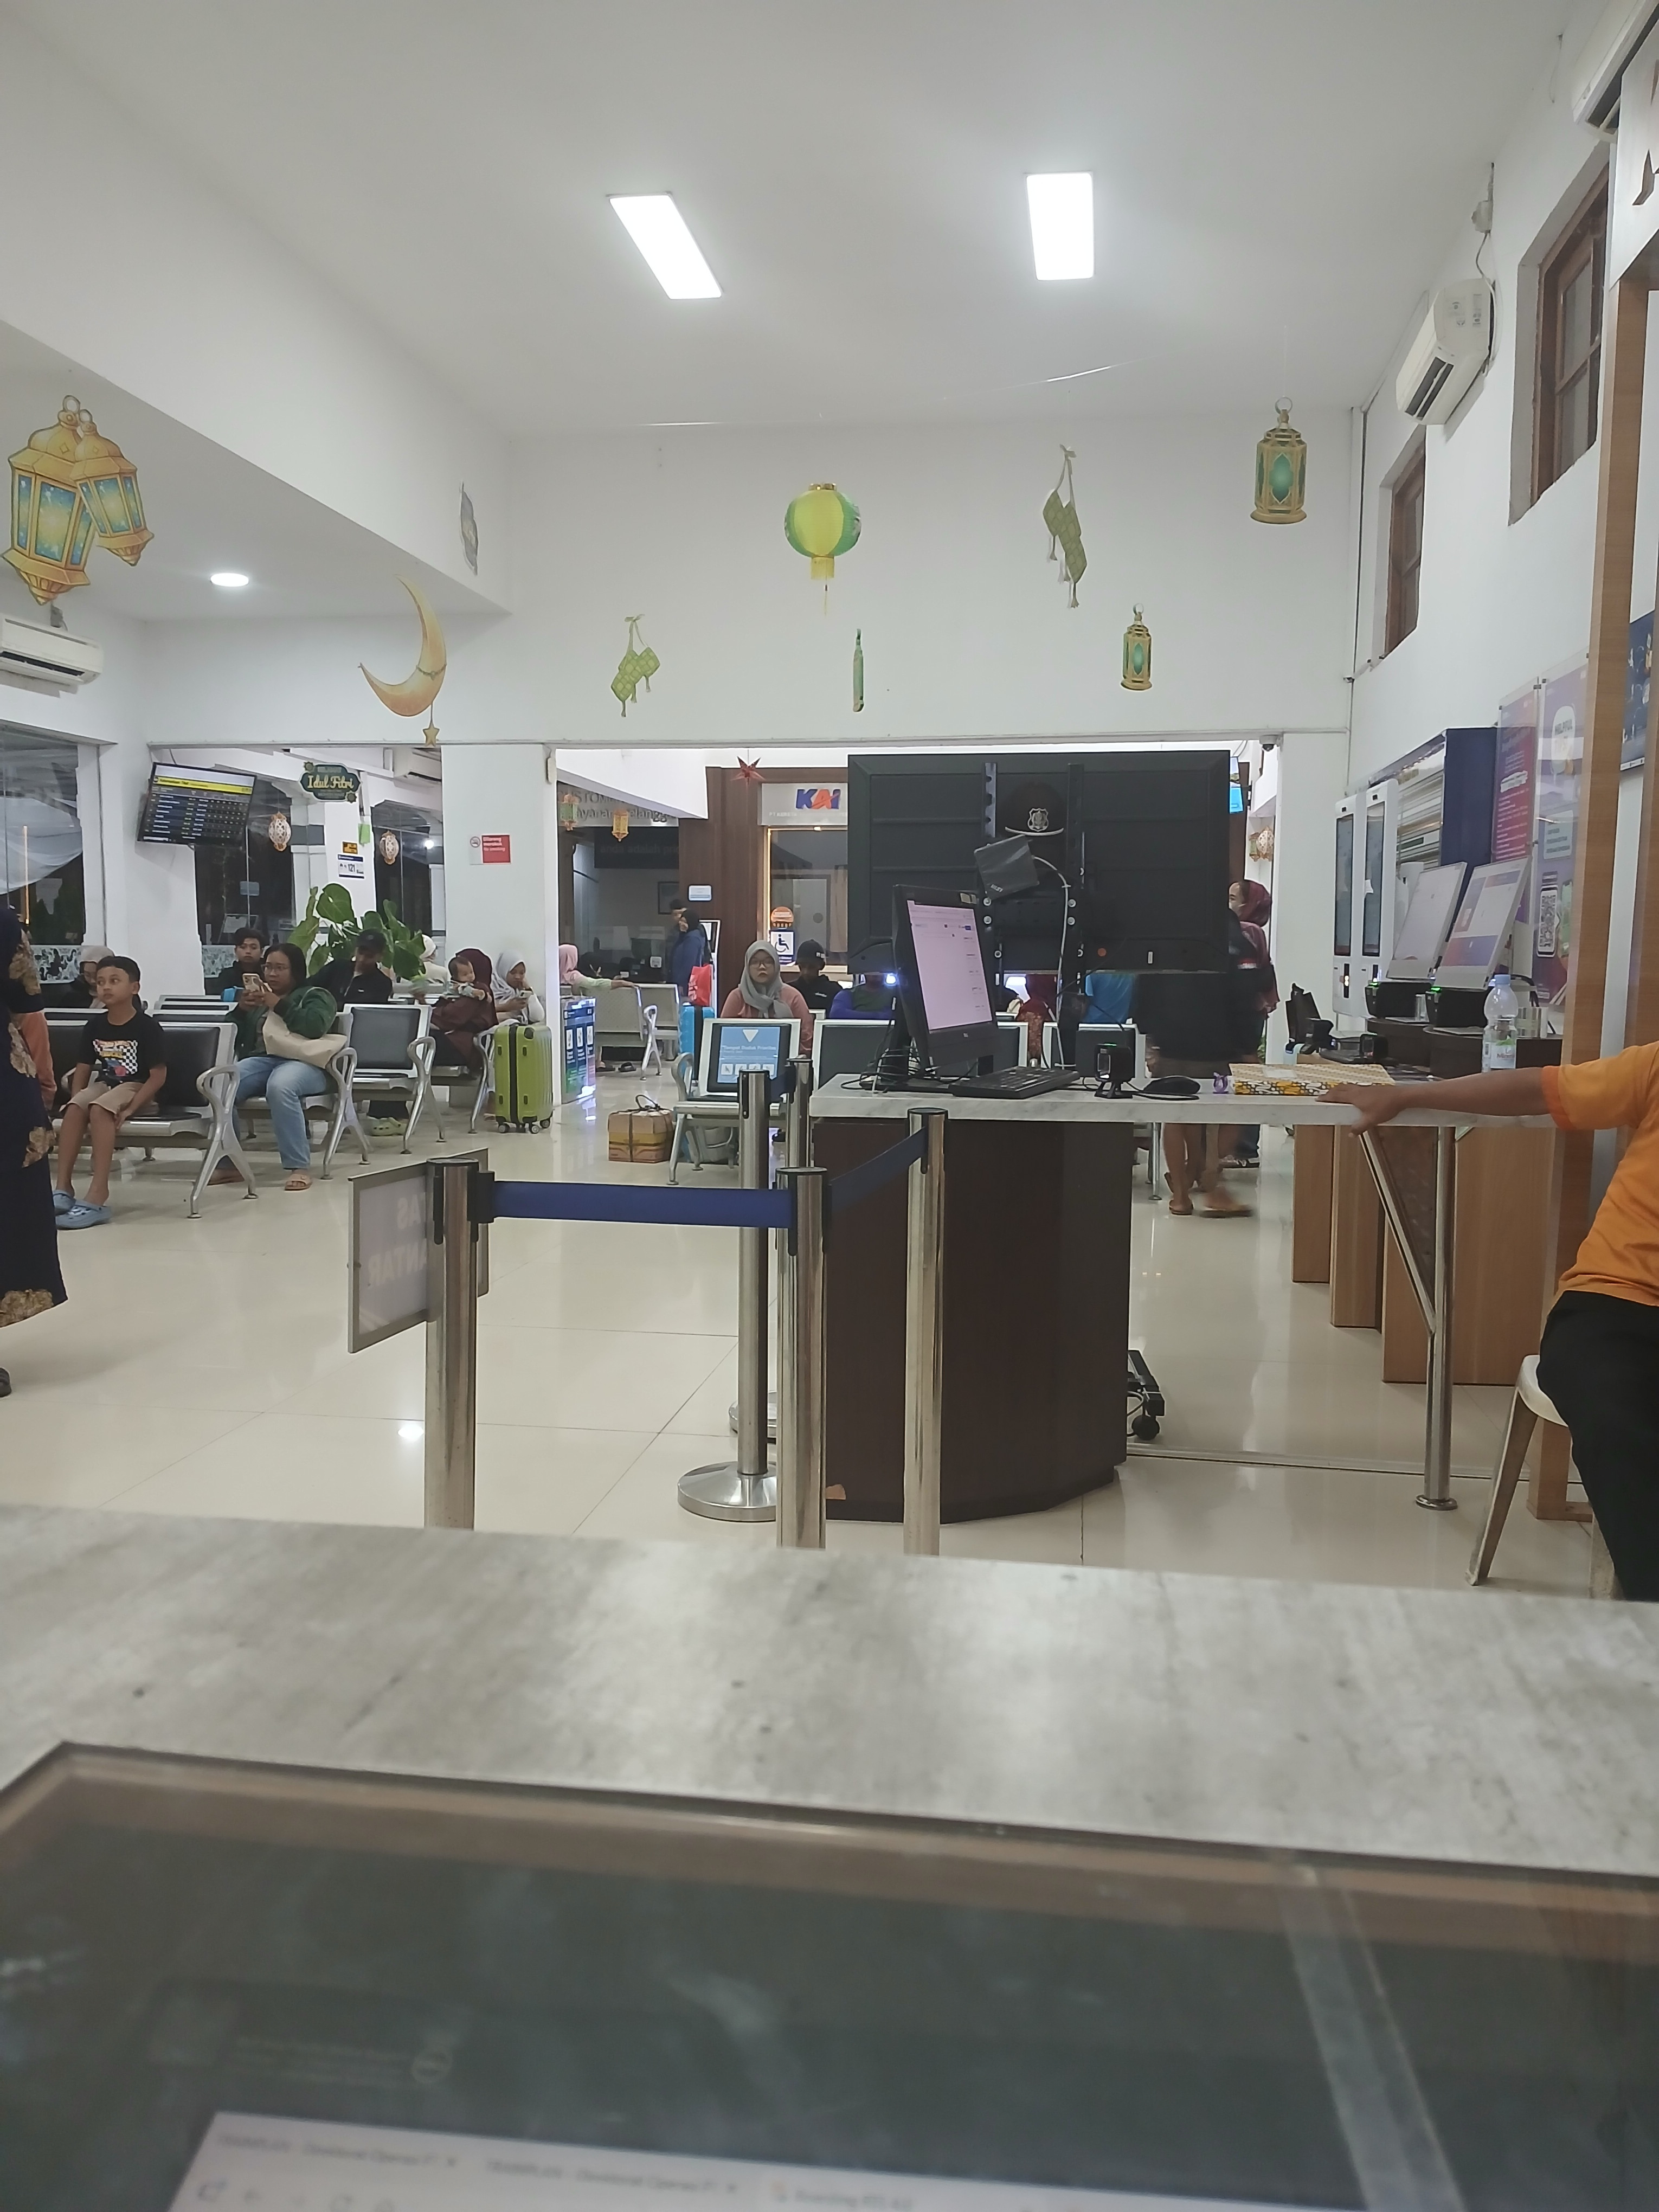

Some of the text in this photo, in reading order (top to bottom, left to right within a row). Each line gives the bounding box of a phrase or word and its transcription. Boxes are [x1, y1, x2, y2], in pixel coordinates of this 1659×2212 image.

[307, 774, 355, 789] Idul Fitri
[796, 789, 841, 809] KAI
